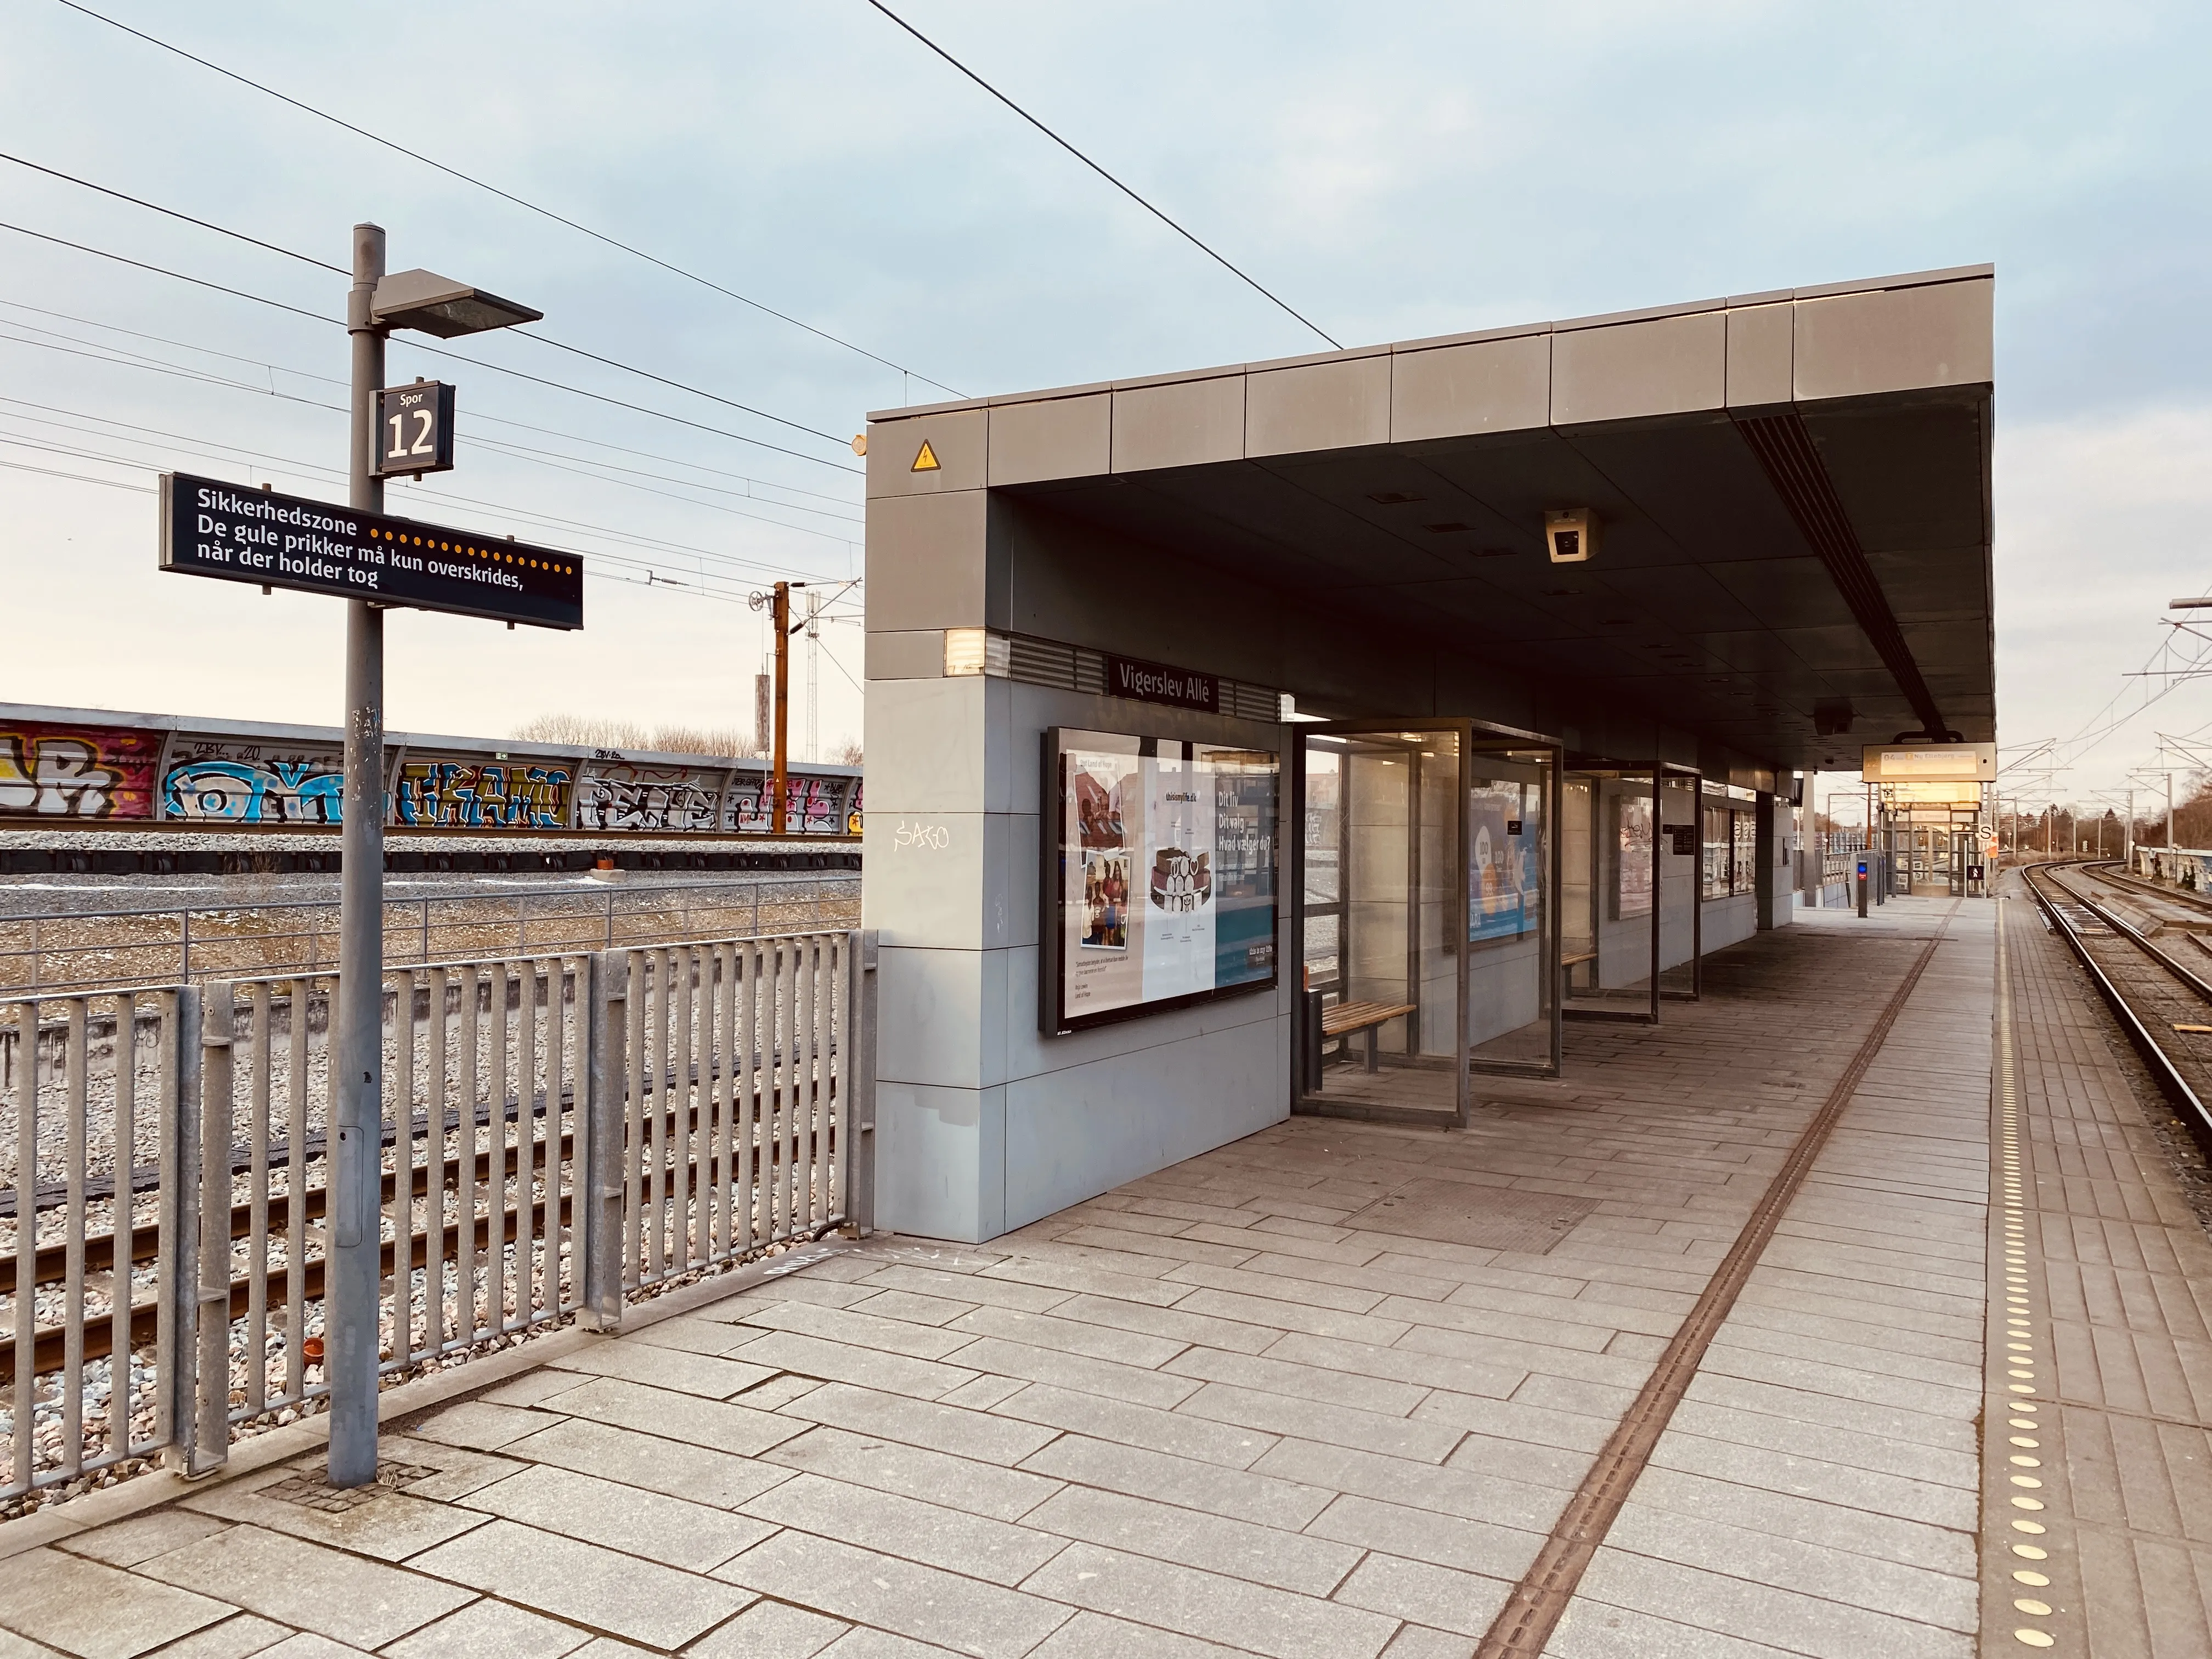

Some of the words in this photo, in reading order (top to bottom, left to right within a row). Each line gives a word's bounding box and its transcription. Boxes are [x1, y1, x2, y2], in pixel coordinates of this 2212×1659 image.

[400, 393, 423, 408] Spor
[388, 409, 433, 459] 12
[198, 488, 357, 536] Sikkerhedszone
[198, 514, 227, 537] De
[234, 524, 278, 546] gule
[285, 534, 353, 559] prikker
[358, 545, 385, 565] må
[391, 549, 422, 571] kun
[427, 561, 523, 591] overskrides,
[198, 540, 233, 562] når
[239, 546, 274, 568] der
[279, 552, 342, 580] holder
[347, 566, 379, 589] tog
[1120, 663, 1182, 697] Vigerslev
[1186, 677, 1209, 702] Allé
[1166, 791, 1197, 804] thisismylife.dk
[1218, 791, 1228, 807] Dit
[1229, 791, 1239, 807] liv
[1218, 813, 1229, 829] Dit
[1229, 814, 1244, 834] valg
[1980, 826, 1991, 839] S
[1218, 835, 1236, 851] Hvad
[1237, 836, 1259, 855] vælger
[1260, 835, 1271, 851] du?
[1480, 842, 1488, 855] 100
